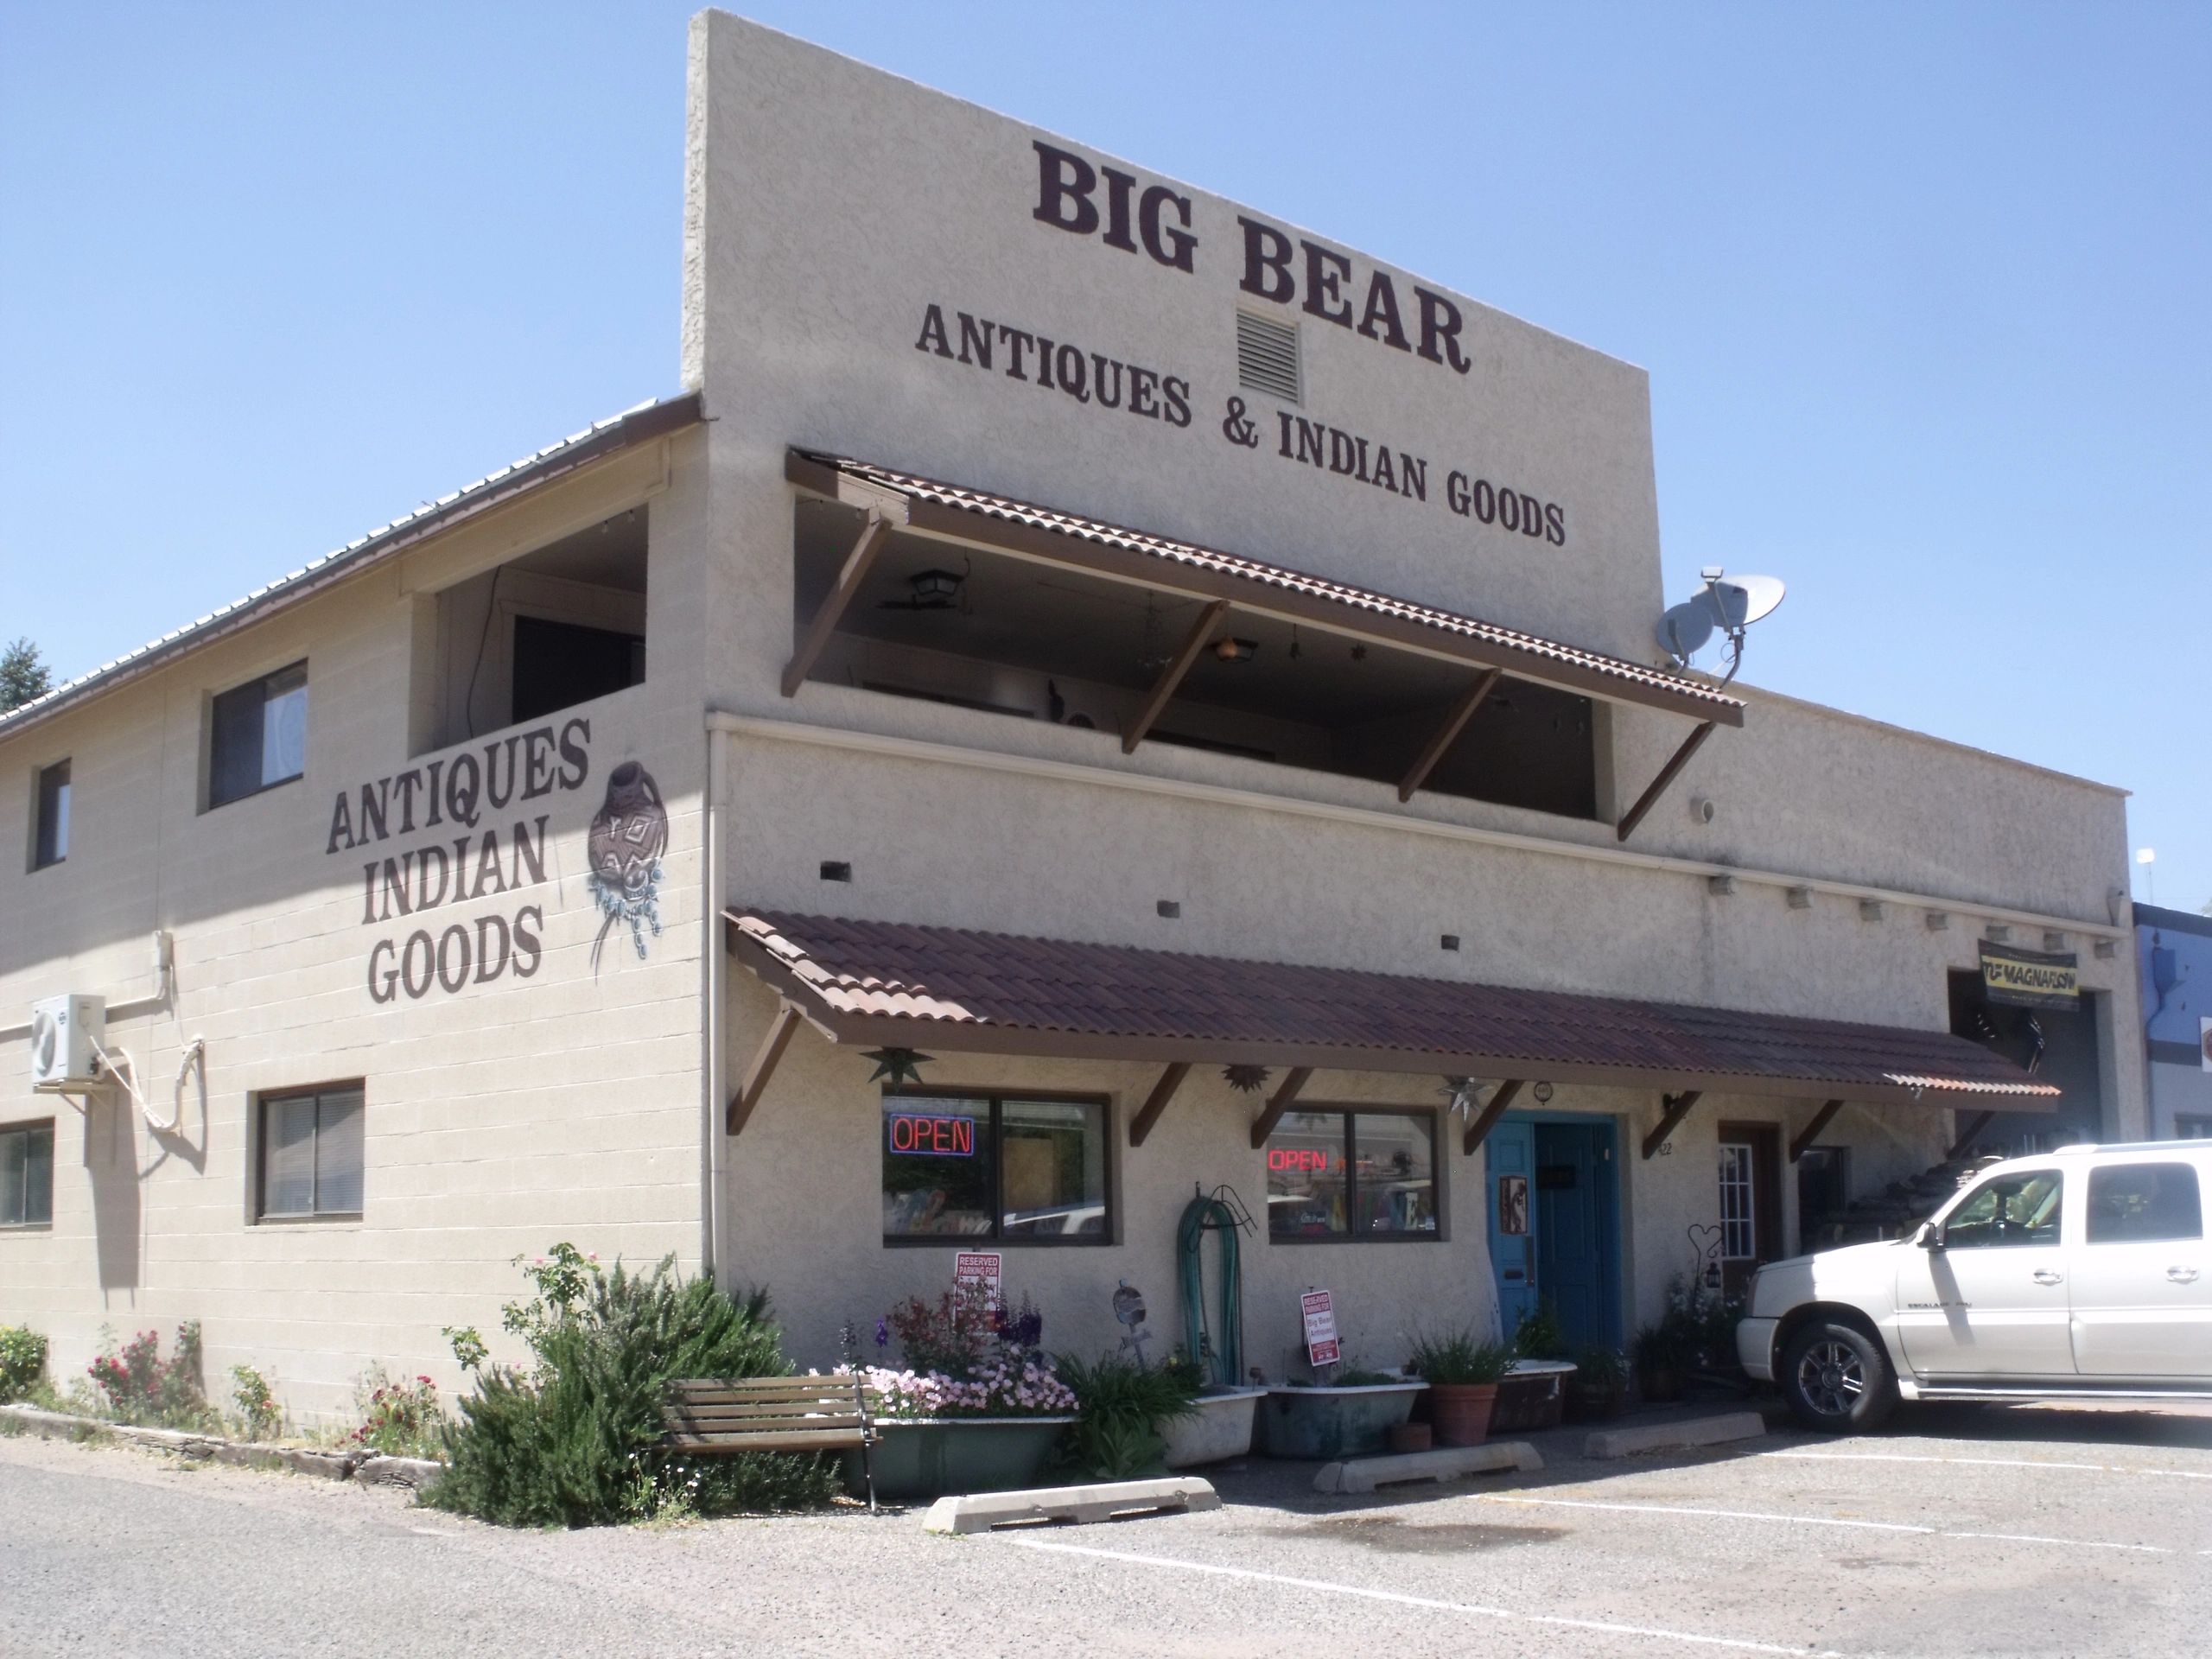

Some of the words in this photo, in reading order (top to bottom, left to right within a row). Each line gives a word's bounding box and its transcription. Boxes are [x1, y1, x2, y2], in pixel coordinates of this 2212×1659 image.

[1033, 139, 1198, 274] BIG
[1237, 214, 1471, 375] BEAR
[914, 303, 1192, 429] ANTIQUES
[1222, 395, 1260, 449] &
[1277, 410, 1429, 503] INDIAN
[1446, 469, 1567, 547] GOODS
[326, 718, 591, 855] ANTIQUES
[361, 815, 550, 925] INDIAN
[367, 904, 543, 1004] GOODS
[893, 1117, 970, 1153] OPEN
[1268, 1149, 1327, 1171] OPEN
[959, 1256, 998, 1266] RESERVED
[959, 1266, 985, 1275] PARKING
[985, 1267, 998, 1275] FOR
